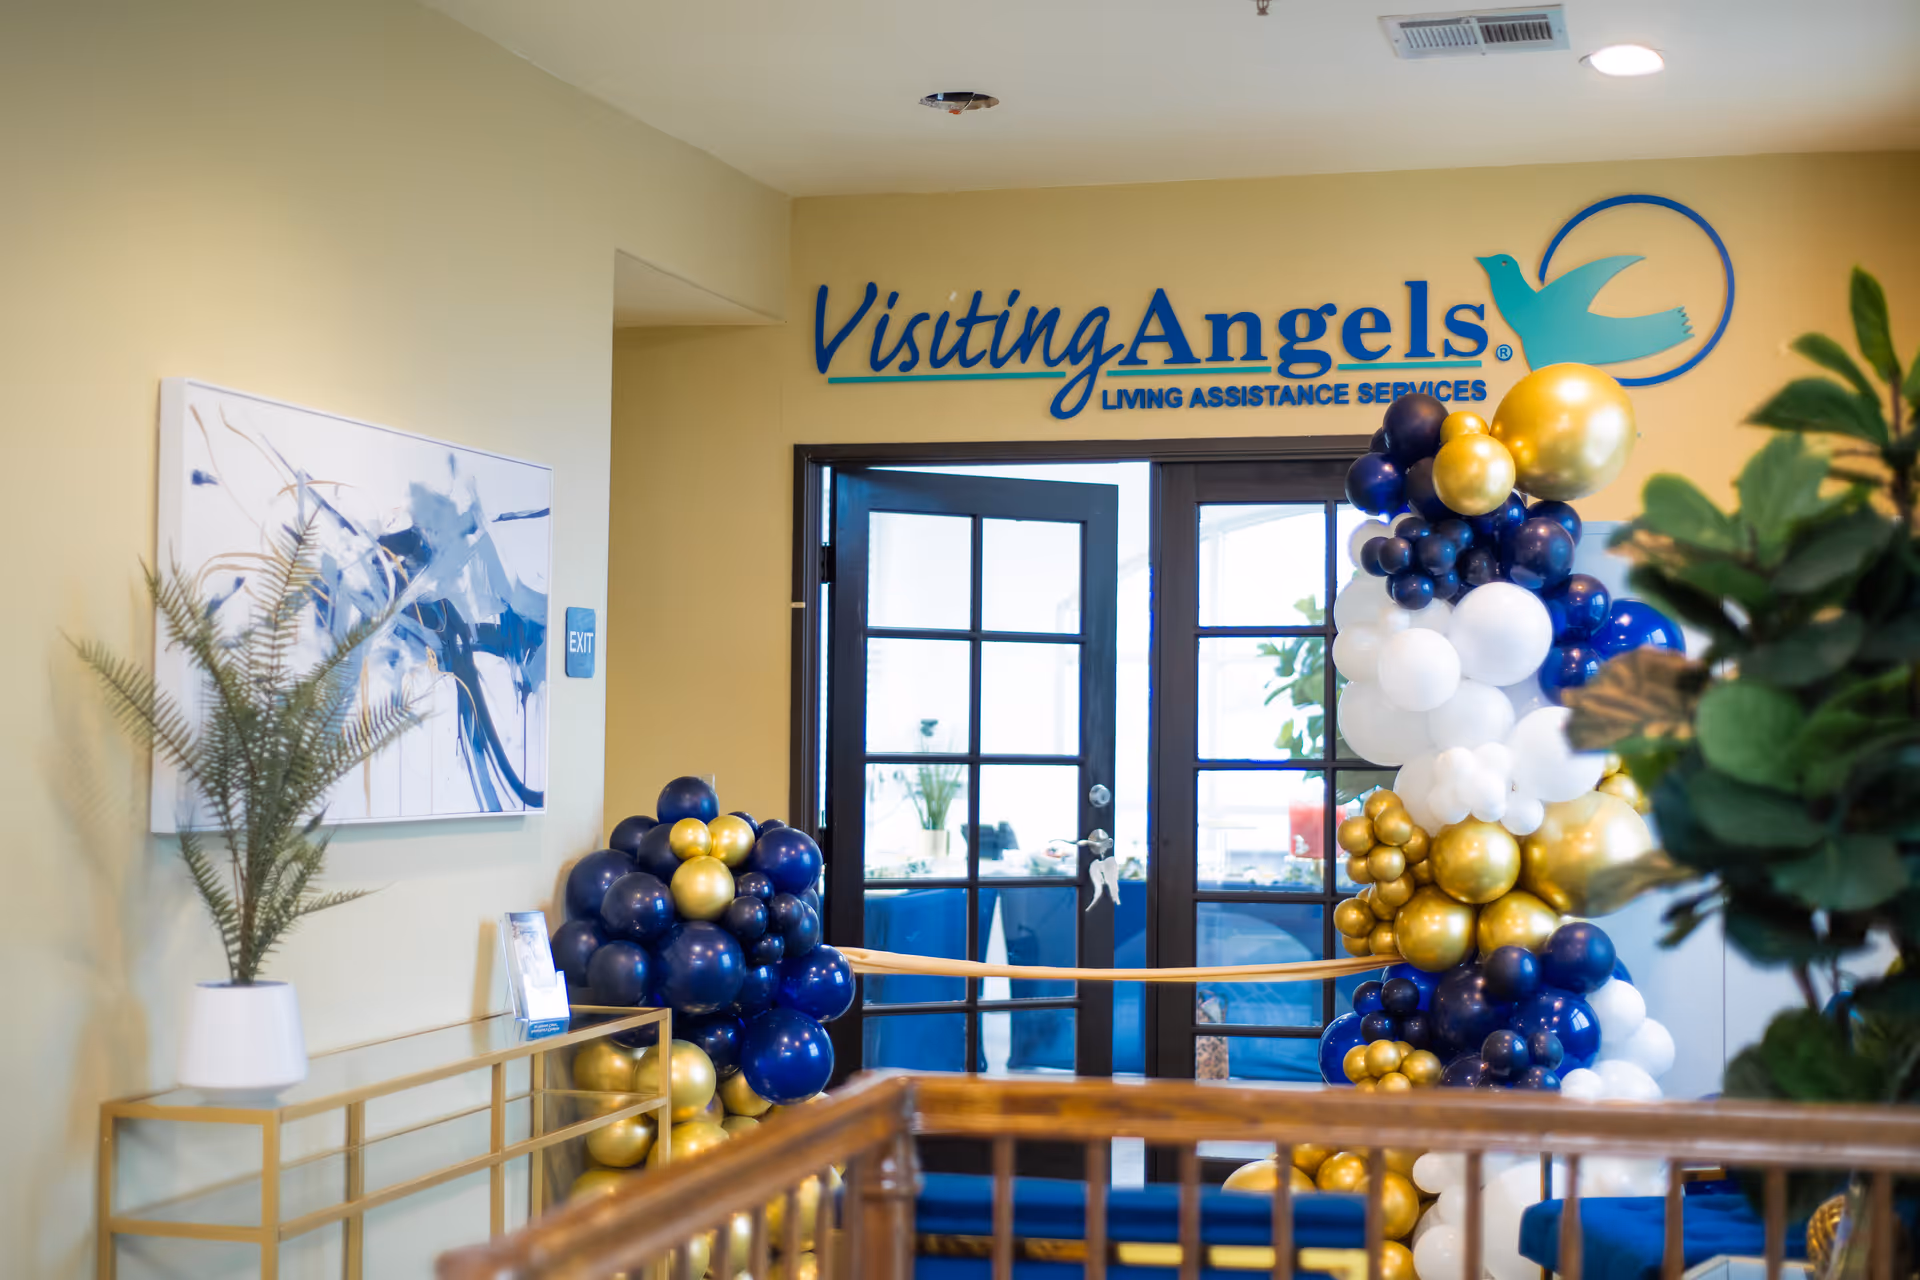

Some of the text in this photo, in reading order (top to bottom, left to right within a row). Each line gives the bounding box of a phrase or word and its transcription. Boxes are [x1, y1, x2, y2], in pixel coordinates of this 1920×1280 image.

[815, 281, 1125, 420] Visiting
[1118, 280, 1489, 379] Angels
[1102, 388, 1183, 410] LIVING
[1189, 383, 1350, 409] ASSISTANCE
[569, 630, 594, 654] EXIT
